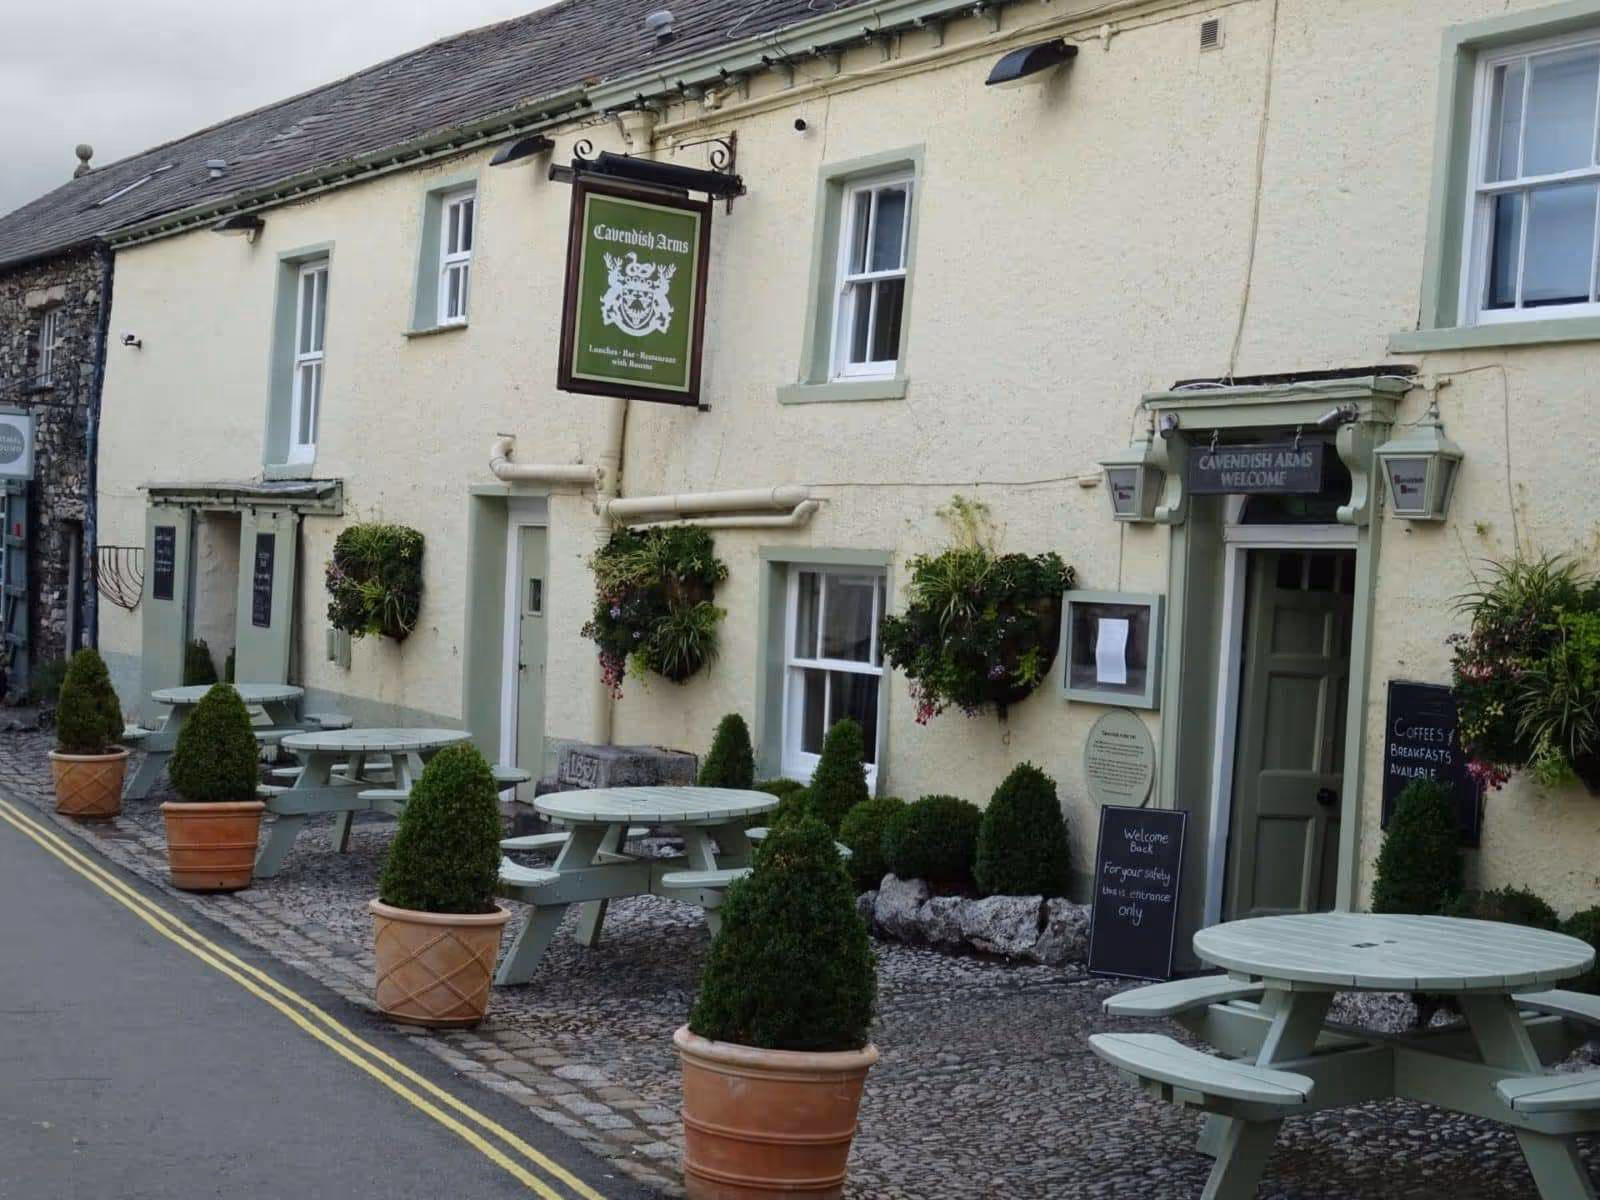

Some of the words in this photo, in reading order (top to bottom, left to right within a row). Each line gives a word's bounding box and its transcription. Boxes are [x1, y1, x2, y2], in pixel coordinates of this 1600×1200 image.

[593, 223, 655, 250] Cavendish
[655, 233, 689, 254] Arms
[1199, 453, 1272, 470] CAVENDISH
[1274, 451, 1313, 468] ARMS
[1221, 471, 1287, 487] WELCOME
[1394, 717, 1444, 742] COFFEES
[1390, 743, 1453, 765] BREAKFASTS
[1124, 828, 1169, 844] Welcome
[1129, 841, 1153, 854] Back
[1103, 861, 1121, 874] For
[1120, 867, 1143, 882] your
[1143, 867, 1171, 887] safety
[1129, 889, 1171, 902] entrance
[1119, 902, 1143, 926] only
